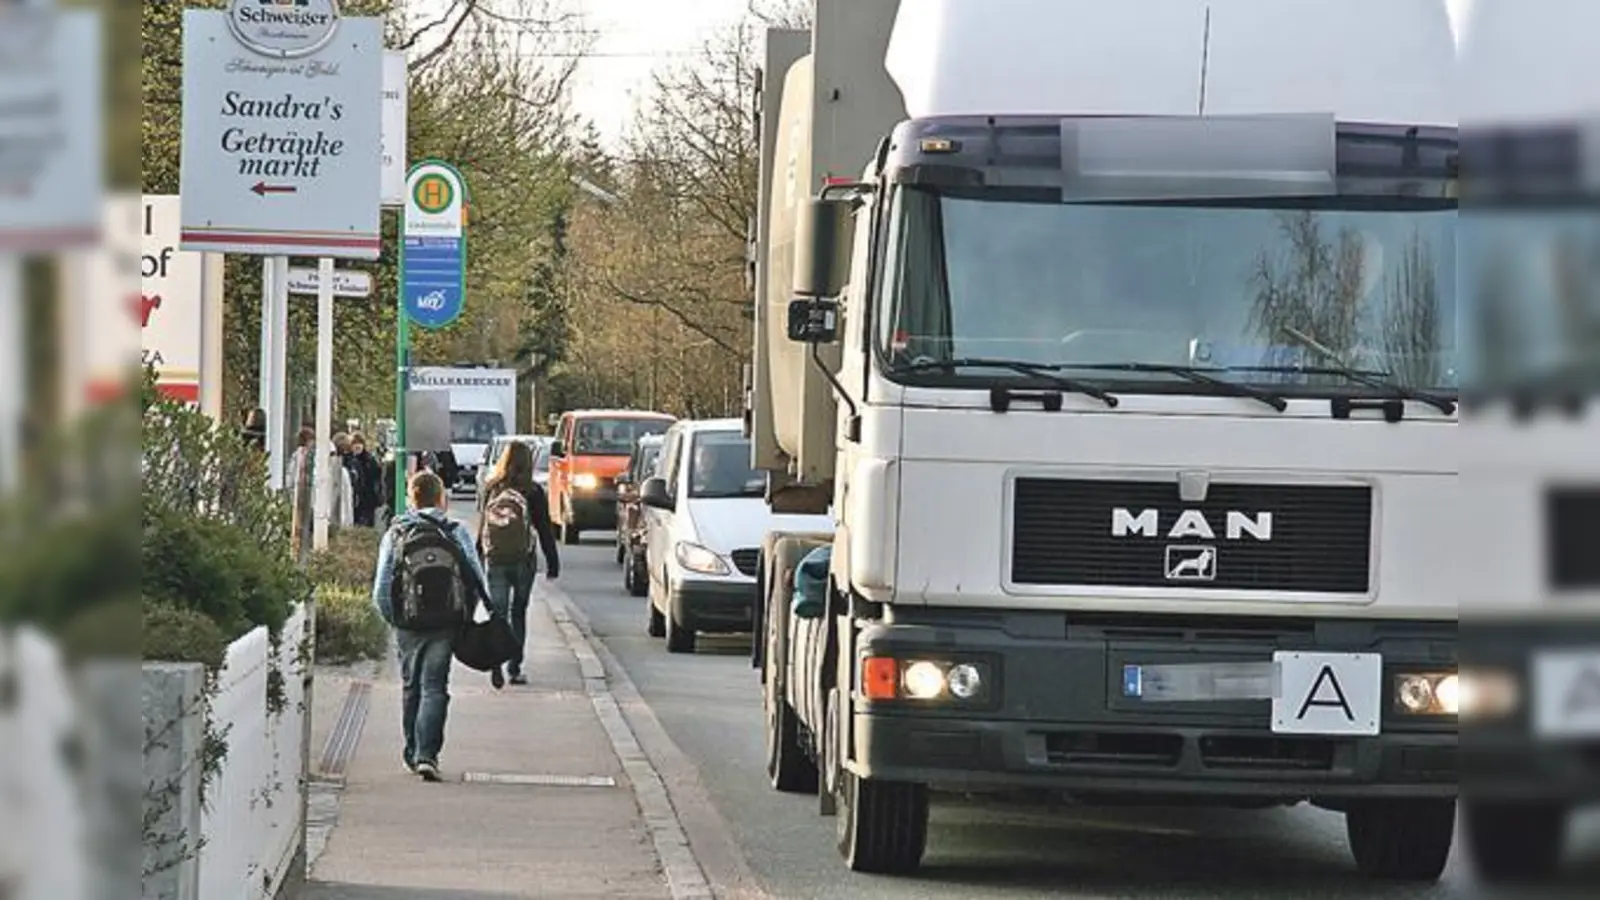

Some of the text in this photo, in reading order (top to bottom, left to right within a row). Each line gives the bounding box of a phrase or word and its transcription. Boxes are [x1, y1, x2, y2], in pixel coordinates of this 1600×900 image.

[240, 7, 329, 27] Schweiger
[221, 91, 343, 120] Sandra's
[221, 127, 344, 156] Getränke
[239, 153, 320, 177] markt
[426, 182, 439, 206] H
[1111, 508, 1273, 541] MAN
[1296, 665, 1355, 721] A
